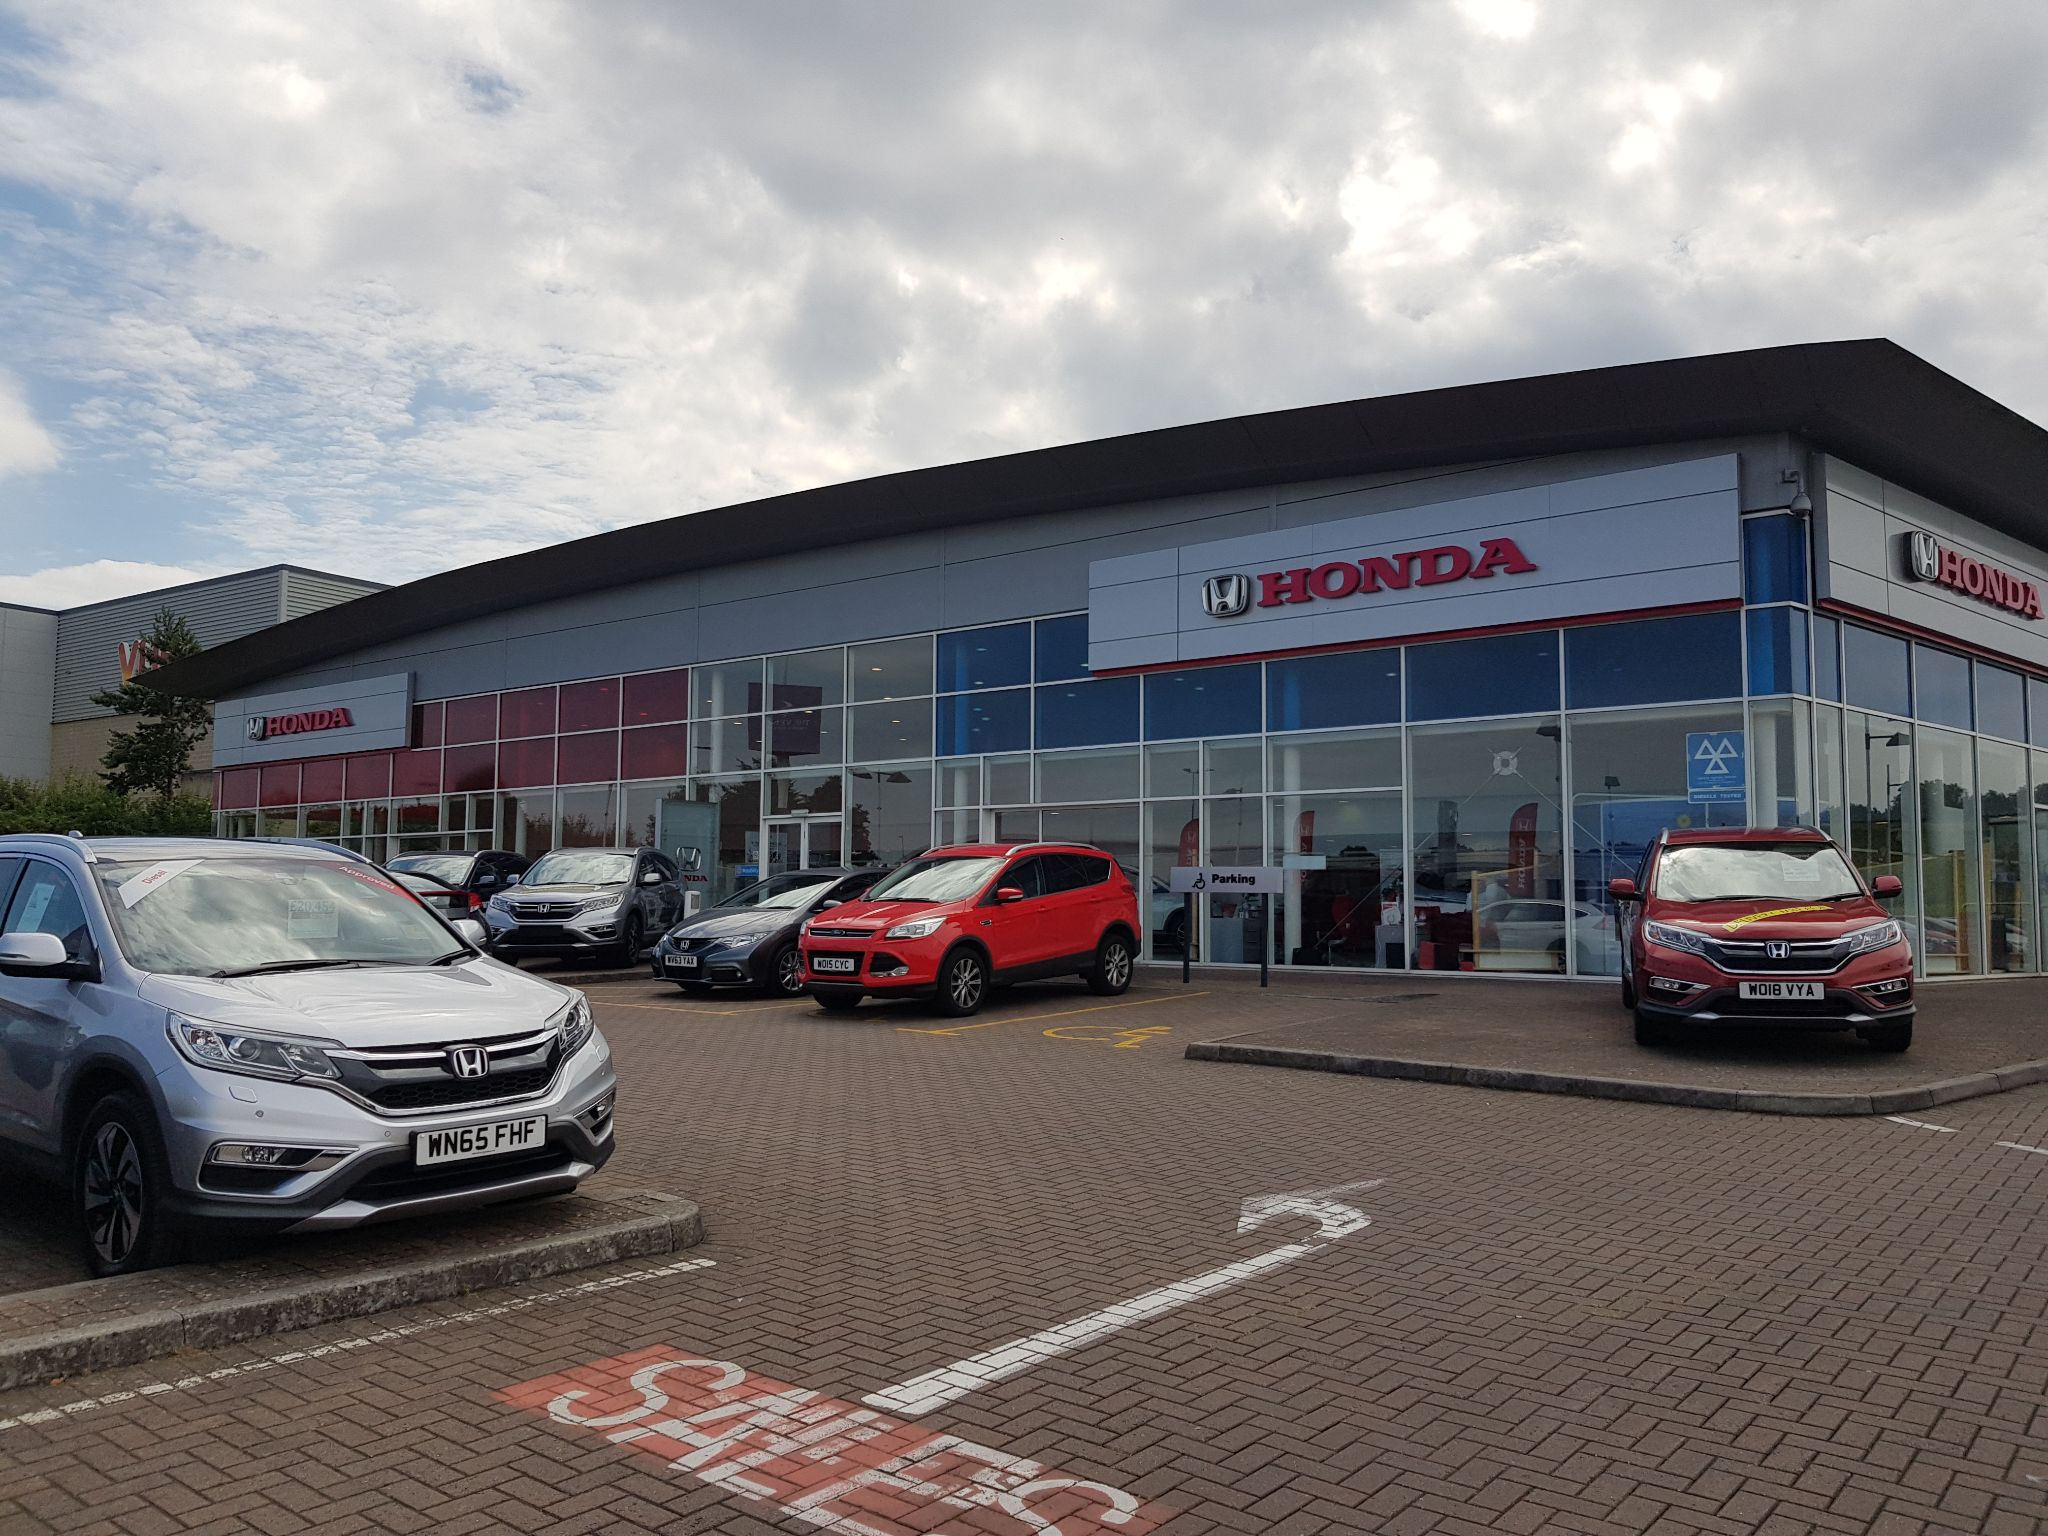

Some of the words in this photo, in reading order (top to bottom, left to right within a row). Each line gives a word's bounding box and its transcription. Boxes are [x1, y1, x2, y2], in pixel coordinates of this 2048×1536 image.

[1257, 537, 1537, 608] HONDA
[1938, 545, 2045, 620] HONDA
[265, 707, 351, 737] HONDA
[142, 869, 168, 885] Diesel
[339, 866, 396, 889] Approved
[684, 874, 708, 882] NDA
[1211, 873, 1256, 885] Parking
[683, 957, 695, 965] YAX
[818, 960, 833, 969] WO15
[834, 960, 849, 970] CYC
[1749, 983, 1782, 996] WO18
[1786, 984, 1815, 997] VYA
[428, 1127, 489, 1158] WN65
[495, 1119, 537, 1148] FHF
